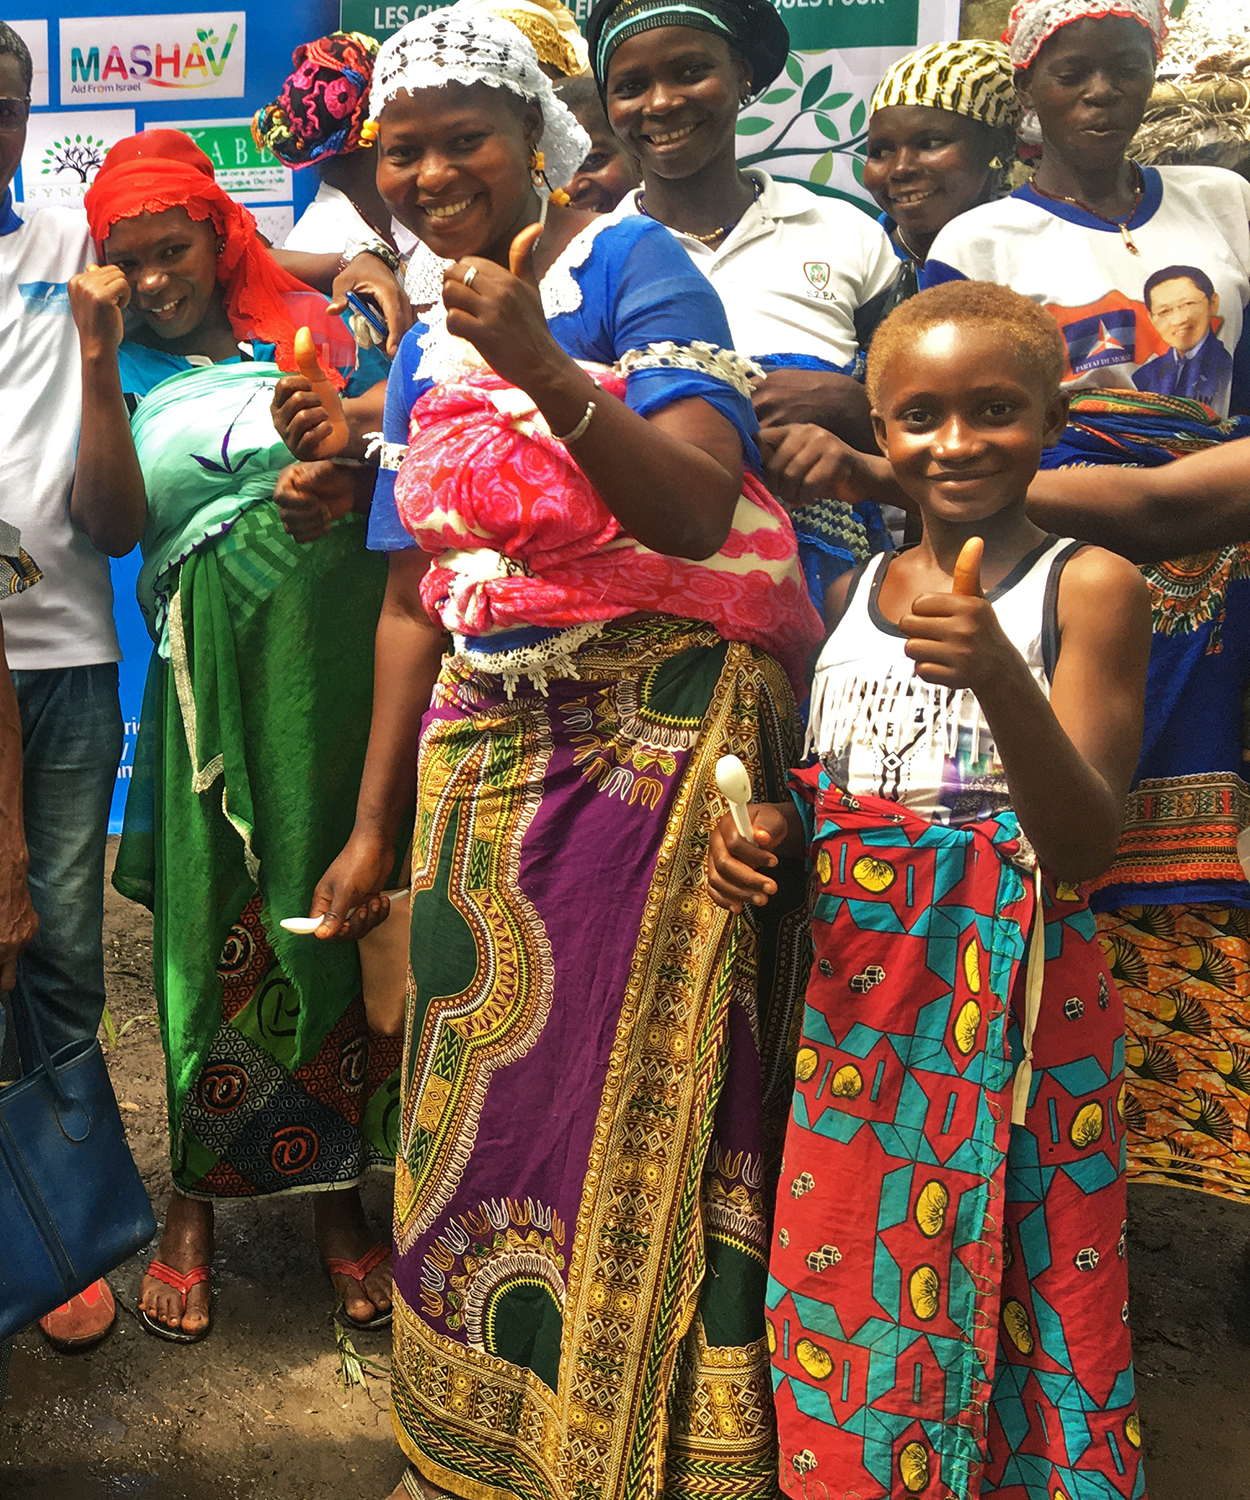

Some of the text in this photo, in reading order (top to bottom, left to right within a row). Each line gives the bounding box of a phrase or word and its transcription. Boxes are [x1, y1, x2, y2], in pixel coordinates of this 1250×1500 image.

[374, 5, 409, 30] LES
[70, 23, 239, 83] MASHAV
[70, 82, 142, 94] Aid From Israel
